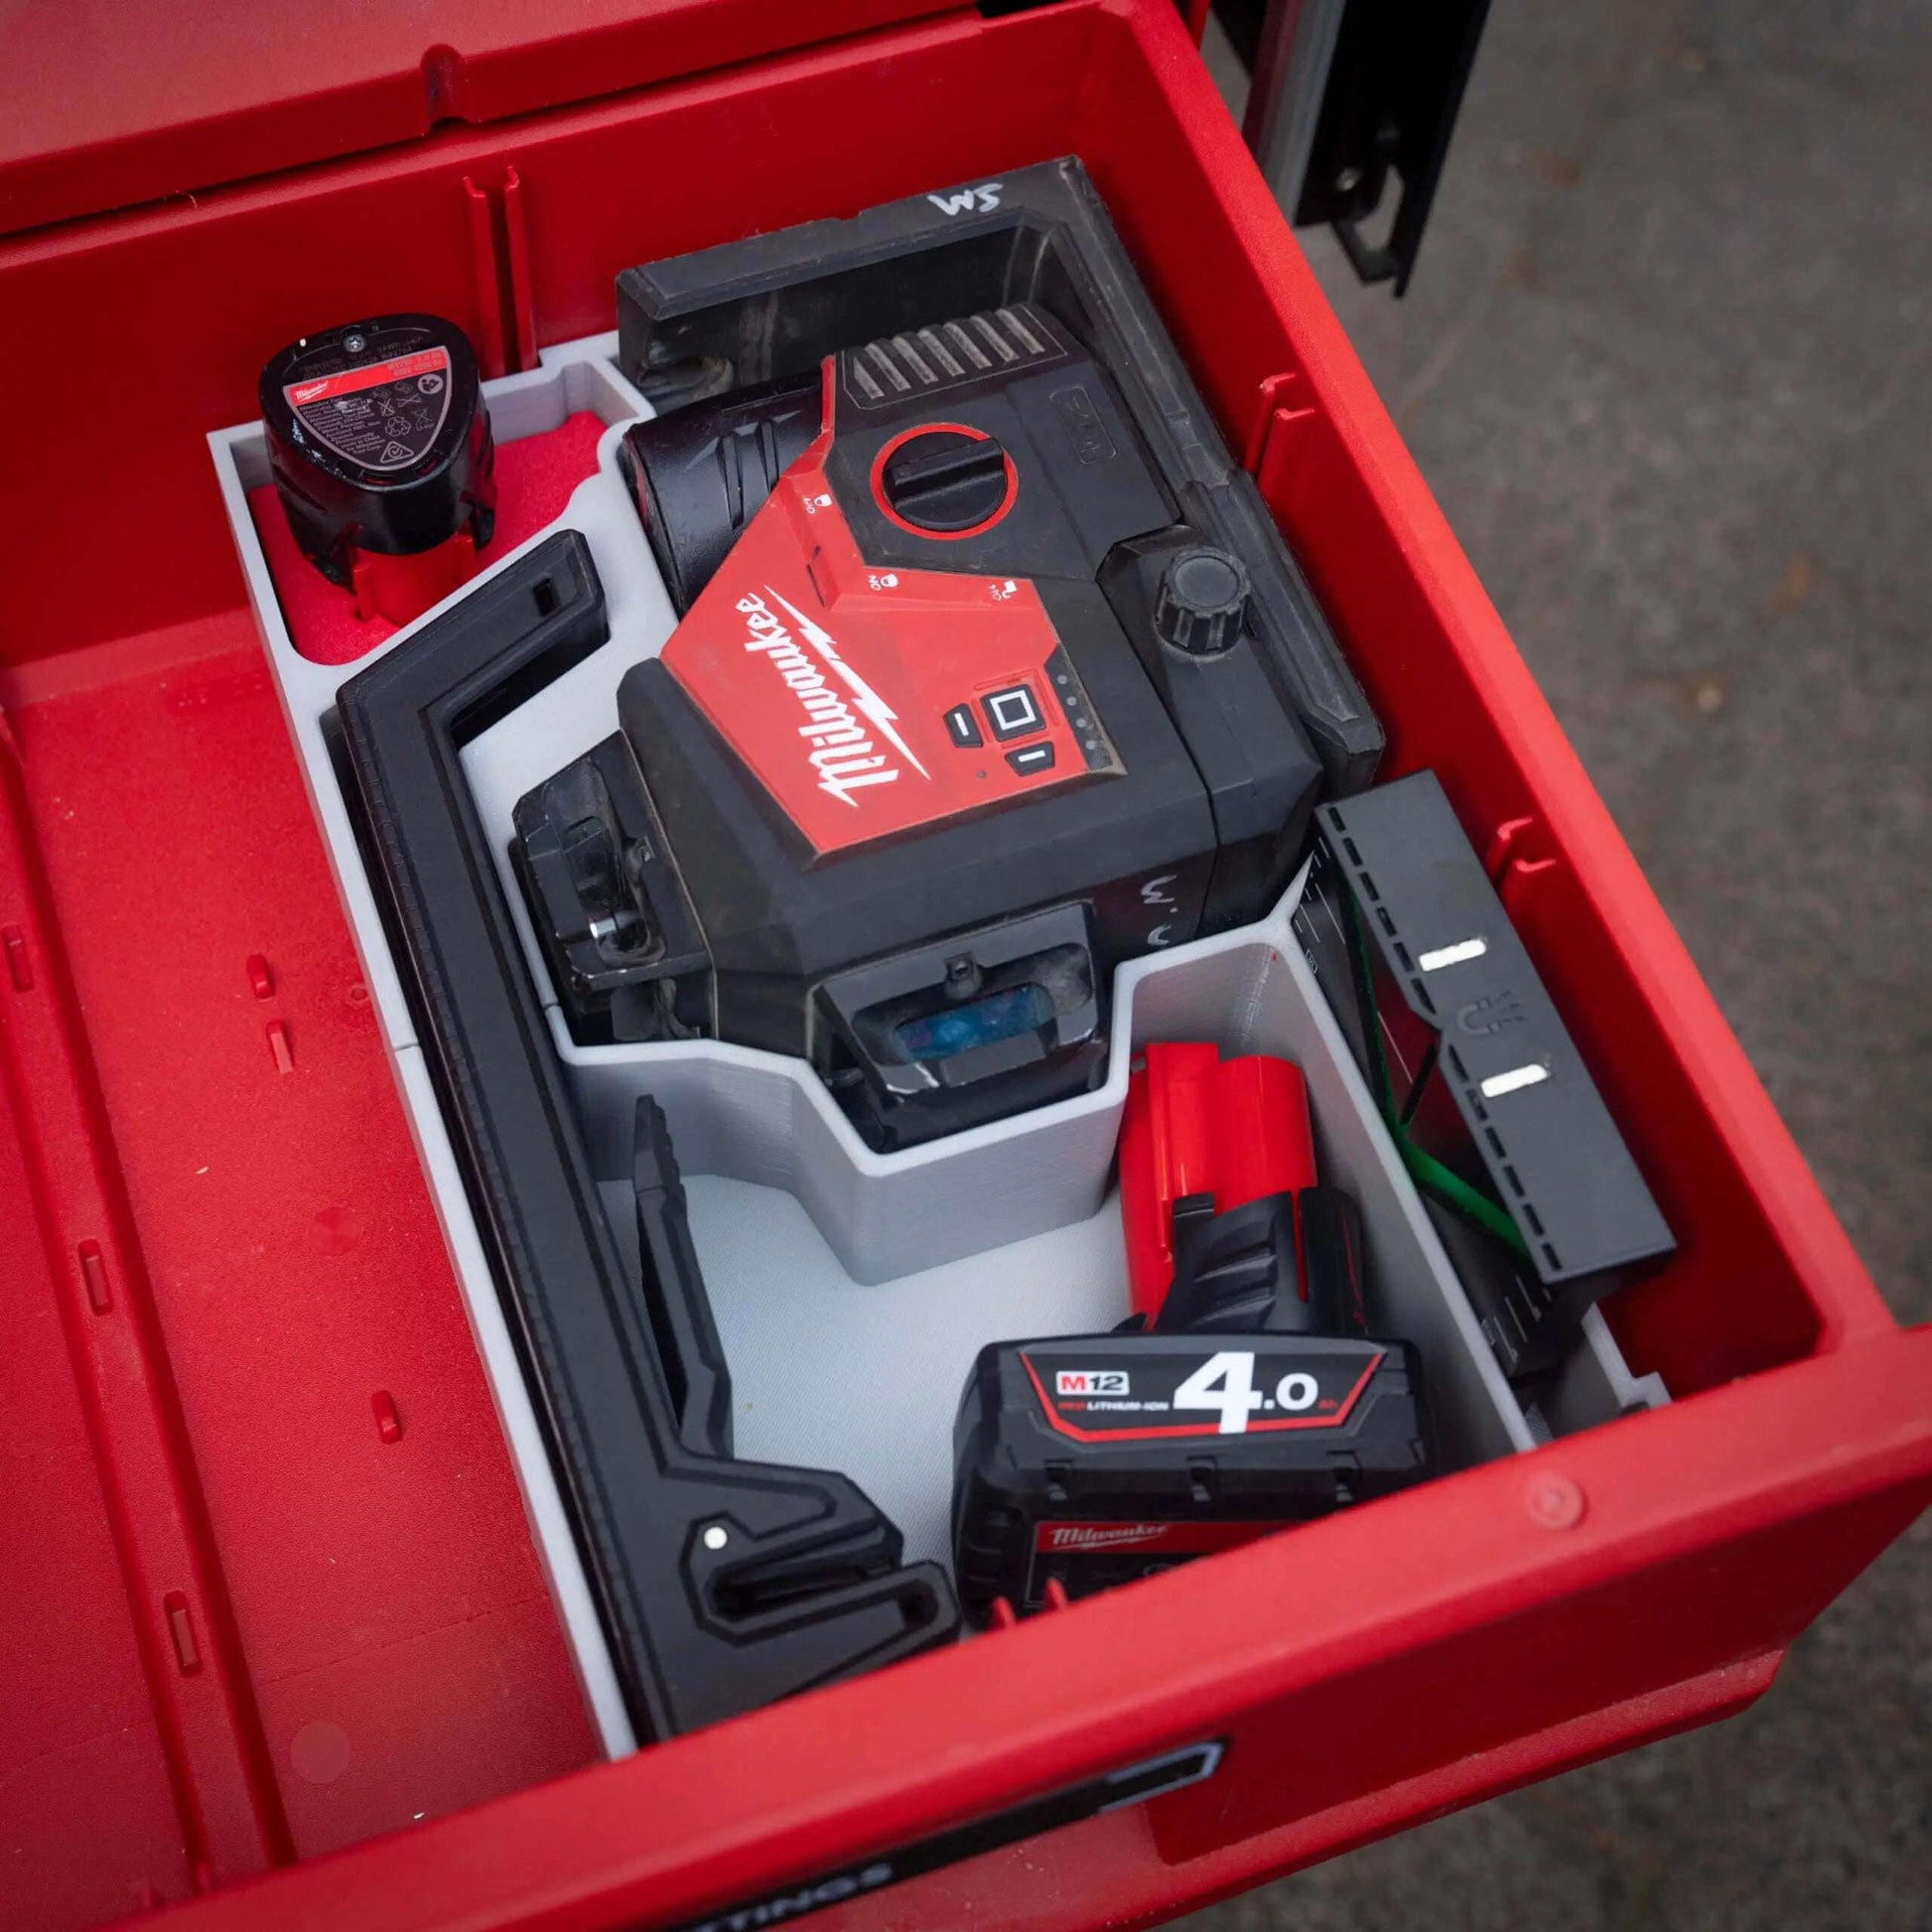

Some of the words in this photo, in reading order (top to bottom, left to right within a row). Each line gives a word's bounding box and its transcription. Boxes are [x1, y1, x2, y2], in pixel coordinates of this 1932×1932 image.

[867, 574, 882, 591] ON
[735, 592, 899, 808] Milwaukee
[1059, 1374, 1126, 1392] M12
[1050, 1523, 1168, 1544] Milwaukee
